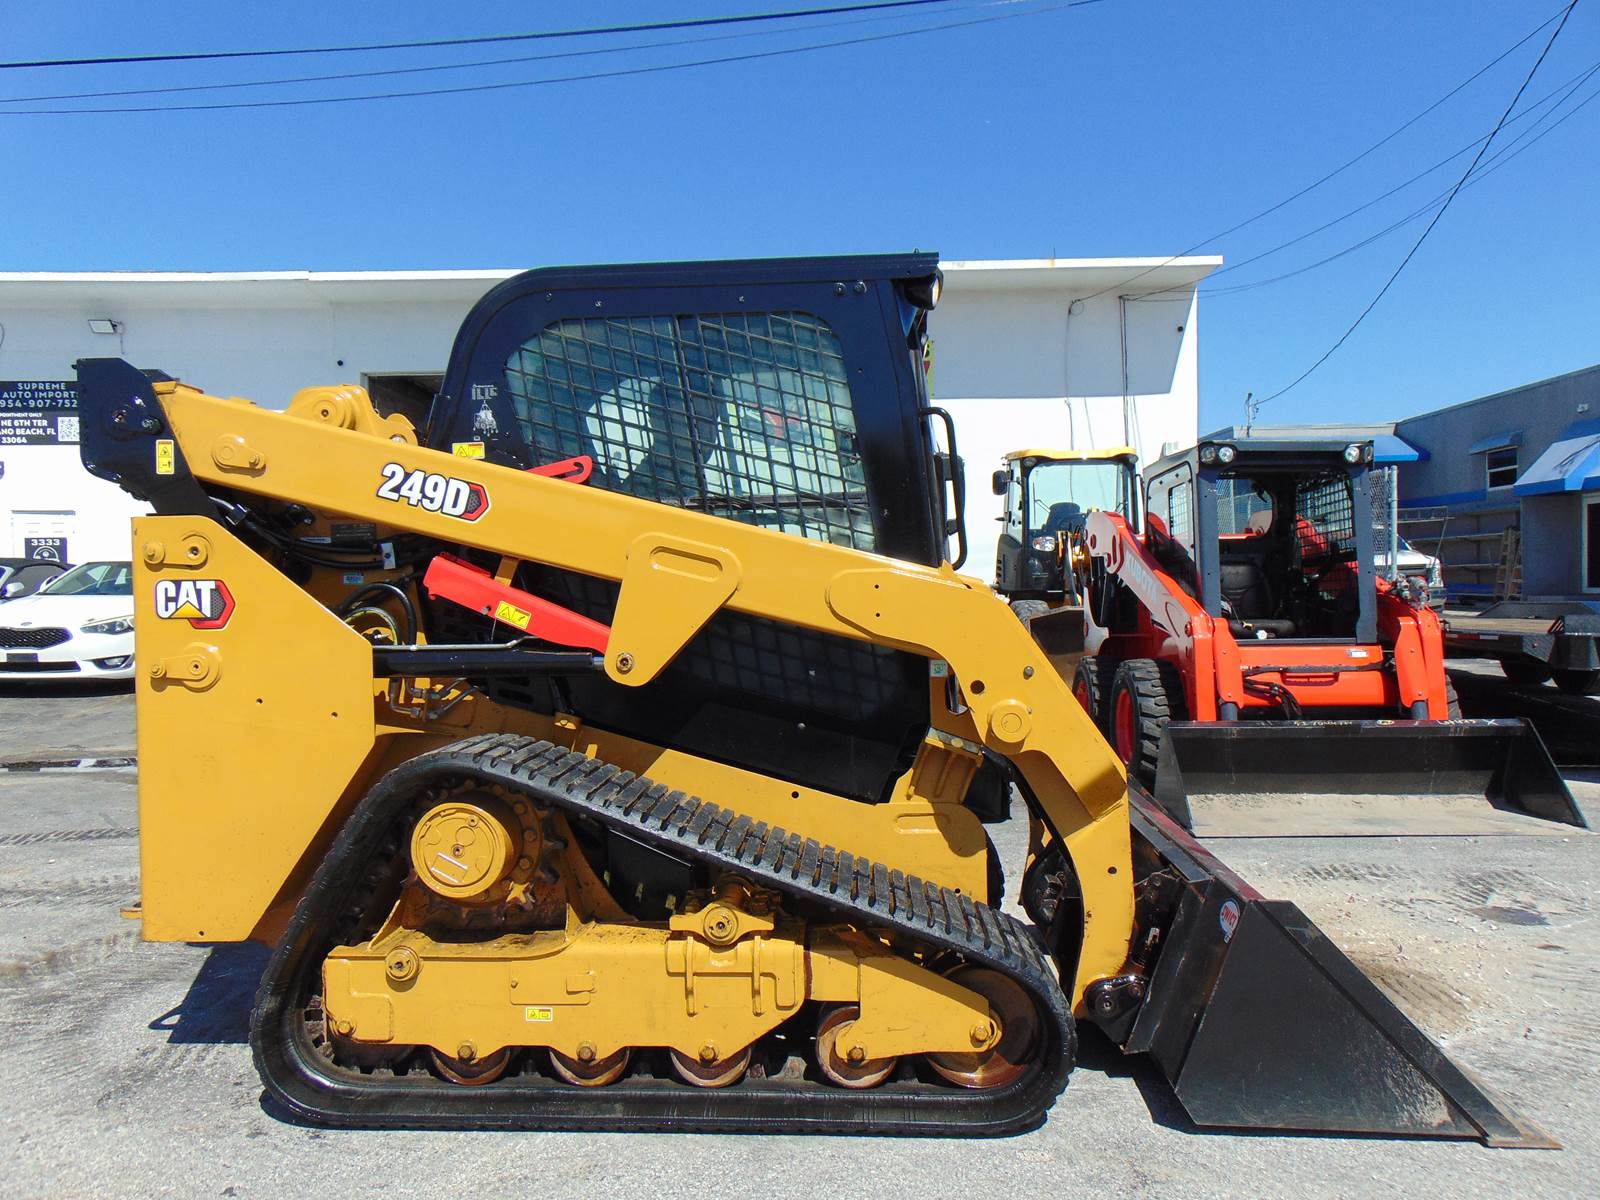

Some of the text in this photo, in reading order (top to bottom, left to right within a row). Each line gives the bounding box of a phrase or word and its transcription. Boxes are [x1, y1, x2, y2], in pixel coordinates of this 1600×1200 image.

[15, 428, 46, 436] BEACH,
[46, 428, 56, 436] FL
[376, 462, 471, 517] 249D
[31, 538, 61, 546] 3333
[156, 580, 216, 618] CAT
